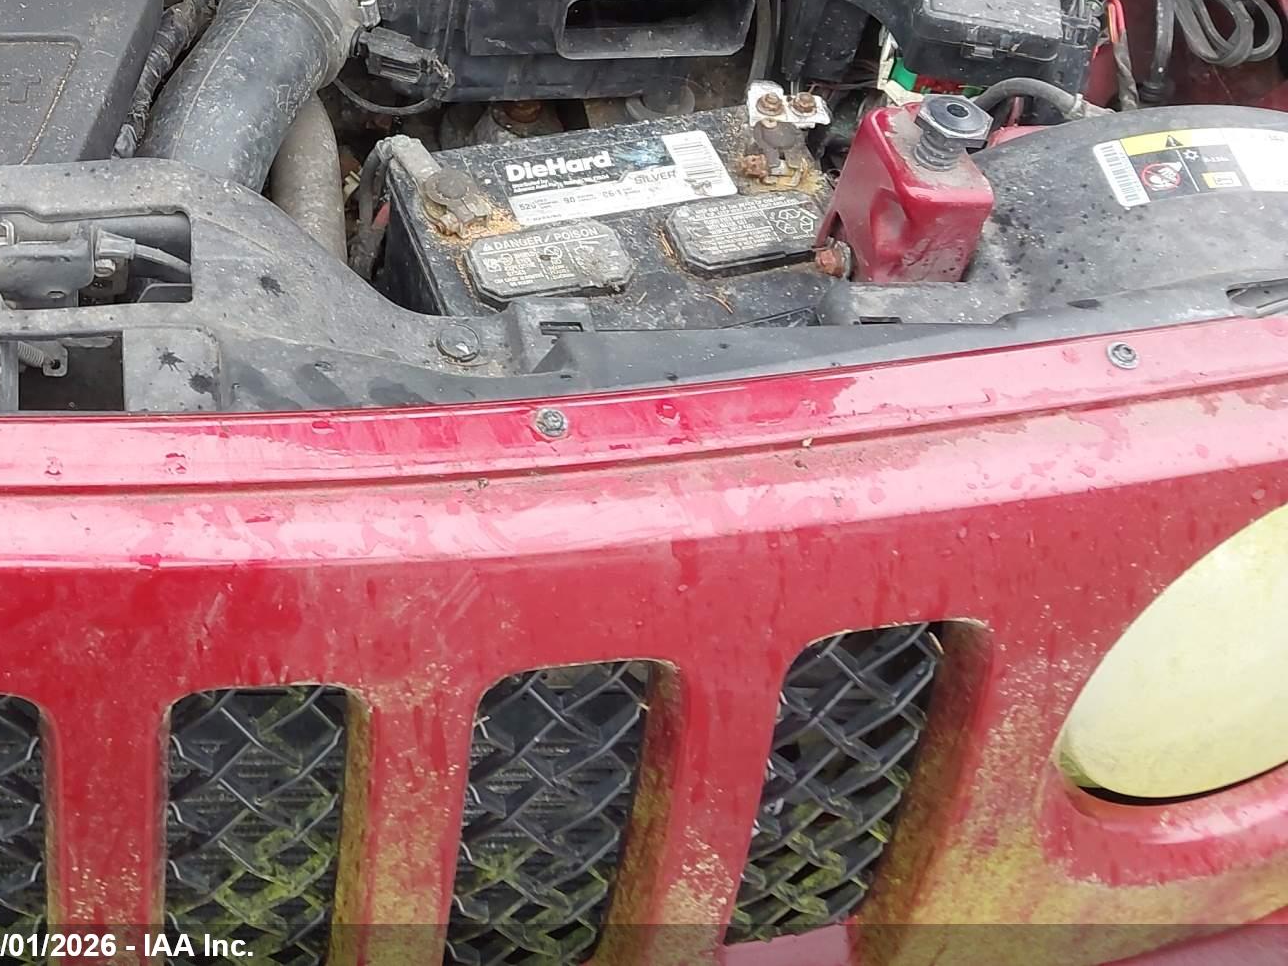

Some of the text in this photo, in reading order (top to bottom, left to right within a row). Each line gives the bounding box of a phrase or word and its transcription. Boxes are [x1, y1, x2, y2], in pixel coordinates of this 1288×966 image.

[505, 150, 613, 183] DieHard
[634, 169, 677, 185] SILVER
[494, 235, 543, 251] DANGER
[554, 227, 599, 242] POISON
